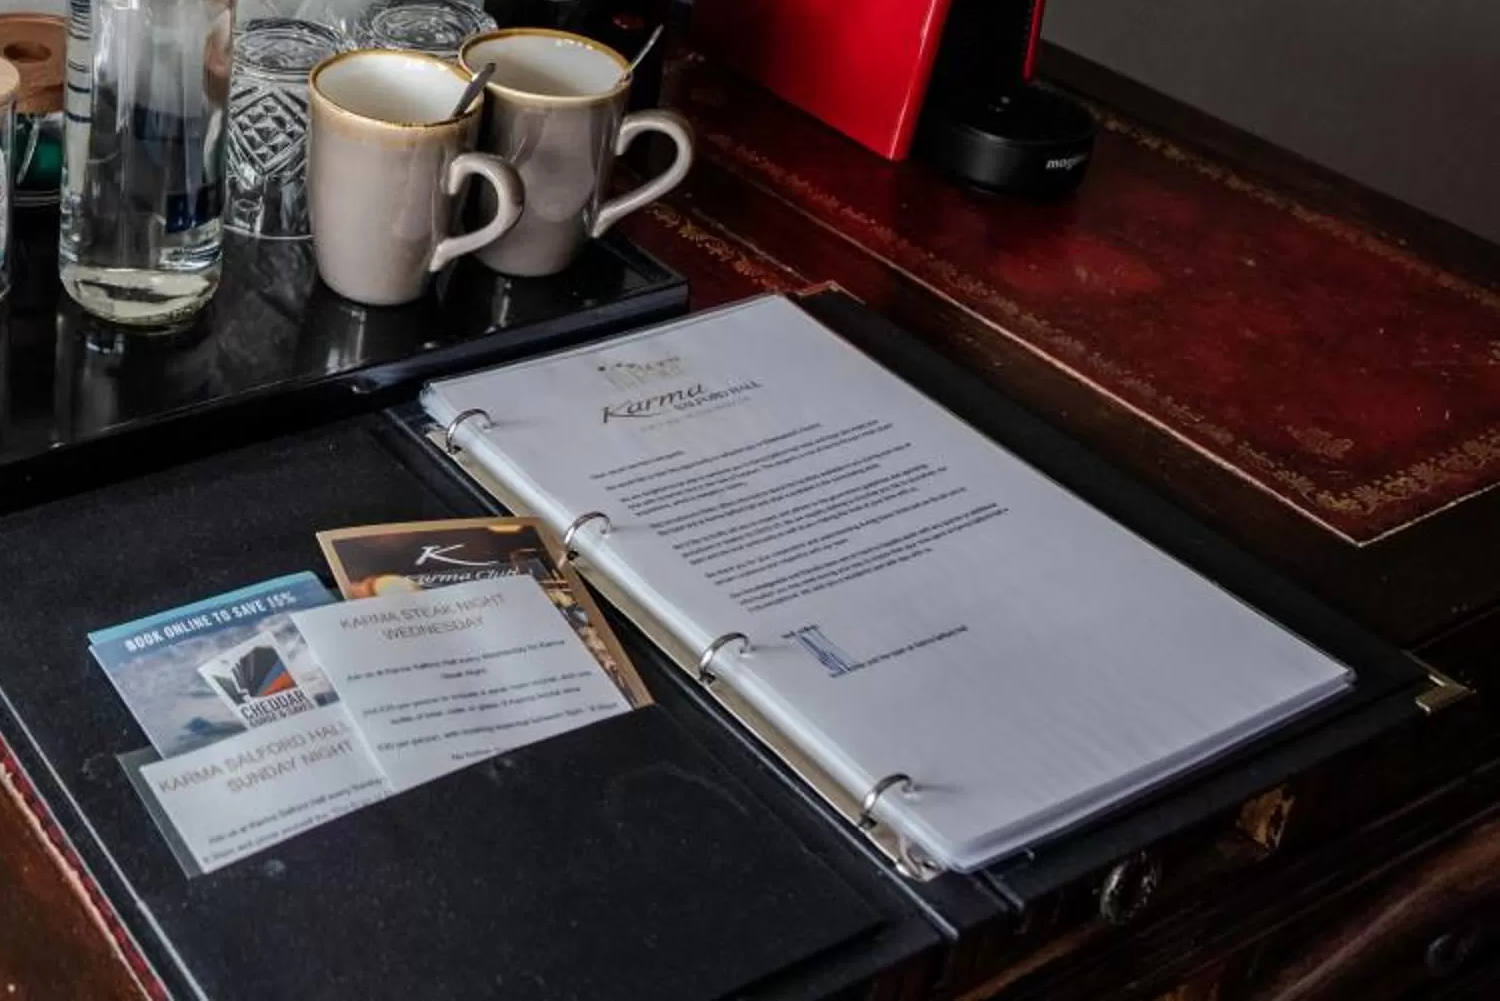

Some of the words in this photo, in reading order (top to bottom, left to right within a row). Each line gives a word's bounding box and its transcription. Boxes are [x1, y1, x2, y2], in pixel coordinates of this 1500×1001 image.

[600, 383, 708, 423] Karma
[124, 627, 164, 653] BOOK
[164, 614, 213, 639] ONLINE
[212, 607, 231, 625] TO
[231, 599, 267, 619] SAVE
[339, 610, 401, 632] KARMA
[403, 601, 453, 623] STEAK
[457, 592, 506, 616] NIGHT
[382, 615, 485, 641] WEDNESDAY
[240, 689, 308, 720] CHEDDAR
[157, 765, 224, 795] KARMA
[224, 732, 307, 770] SALFORD
[226, 757, 298, 793] SUNDAY
[300, 739, 354, 767] NIGHT
